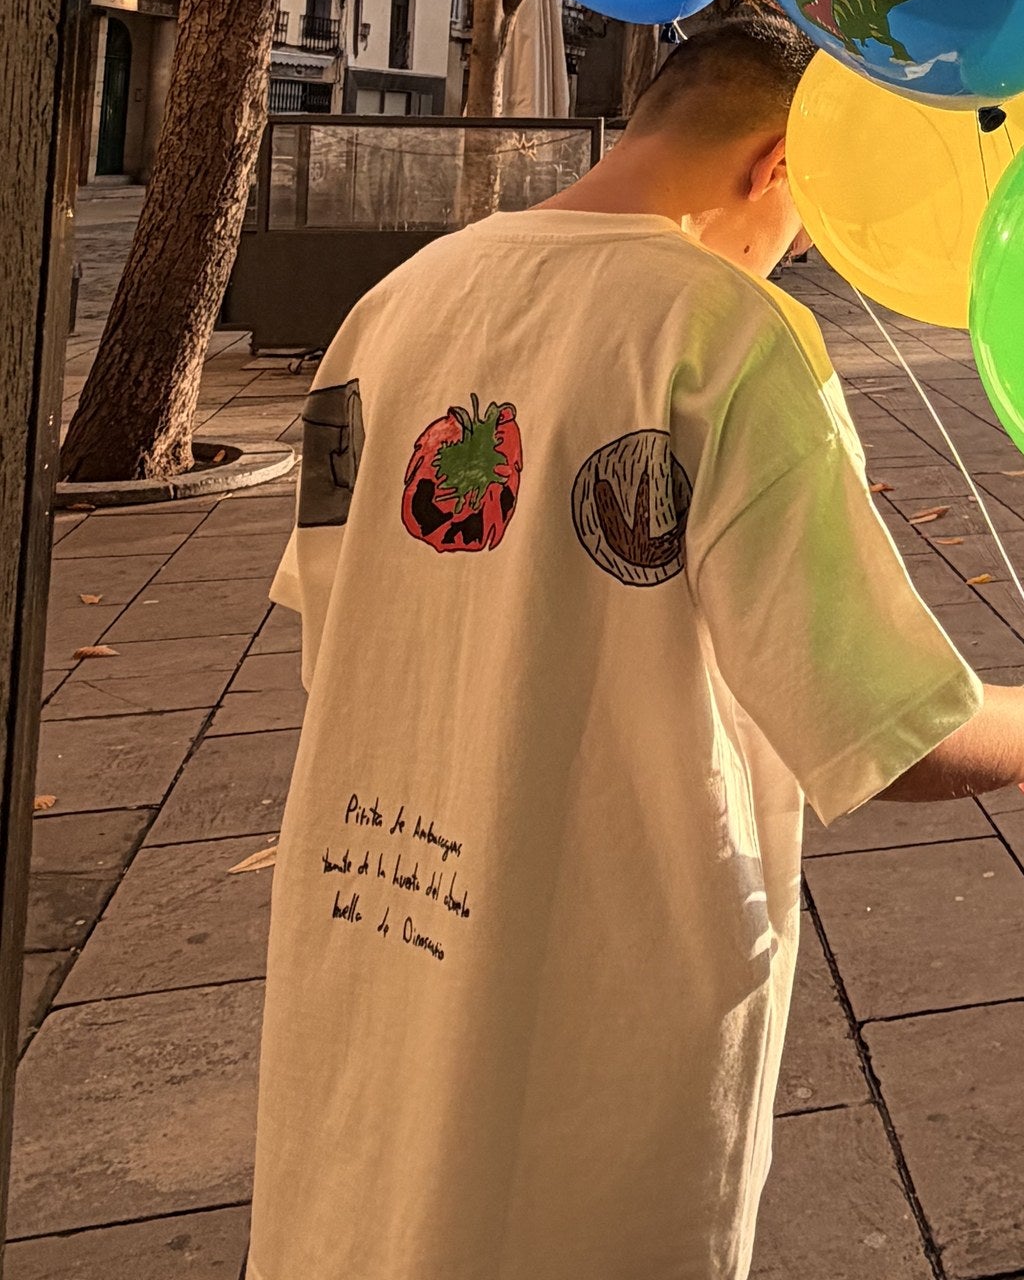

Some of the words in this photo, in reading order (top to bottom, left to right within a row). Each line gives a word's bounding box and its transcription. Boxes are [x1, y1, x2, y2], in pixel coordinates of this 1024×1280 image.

[389, 805, 405, 835] de
[357, 850, 369, 875] de
[376, 852, 386, 879] la
[425, 871, 443, 901] del
[376, 906, 389, 938] de
